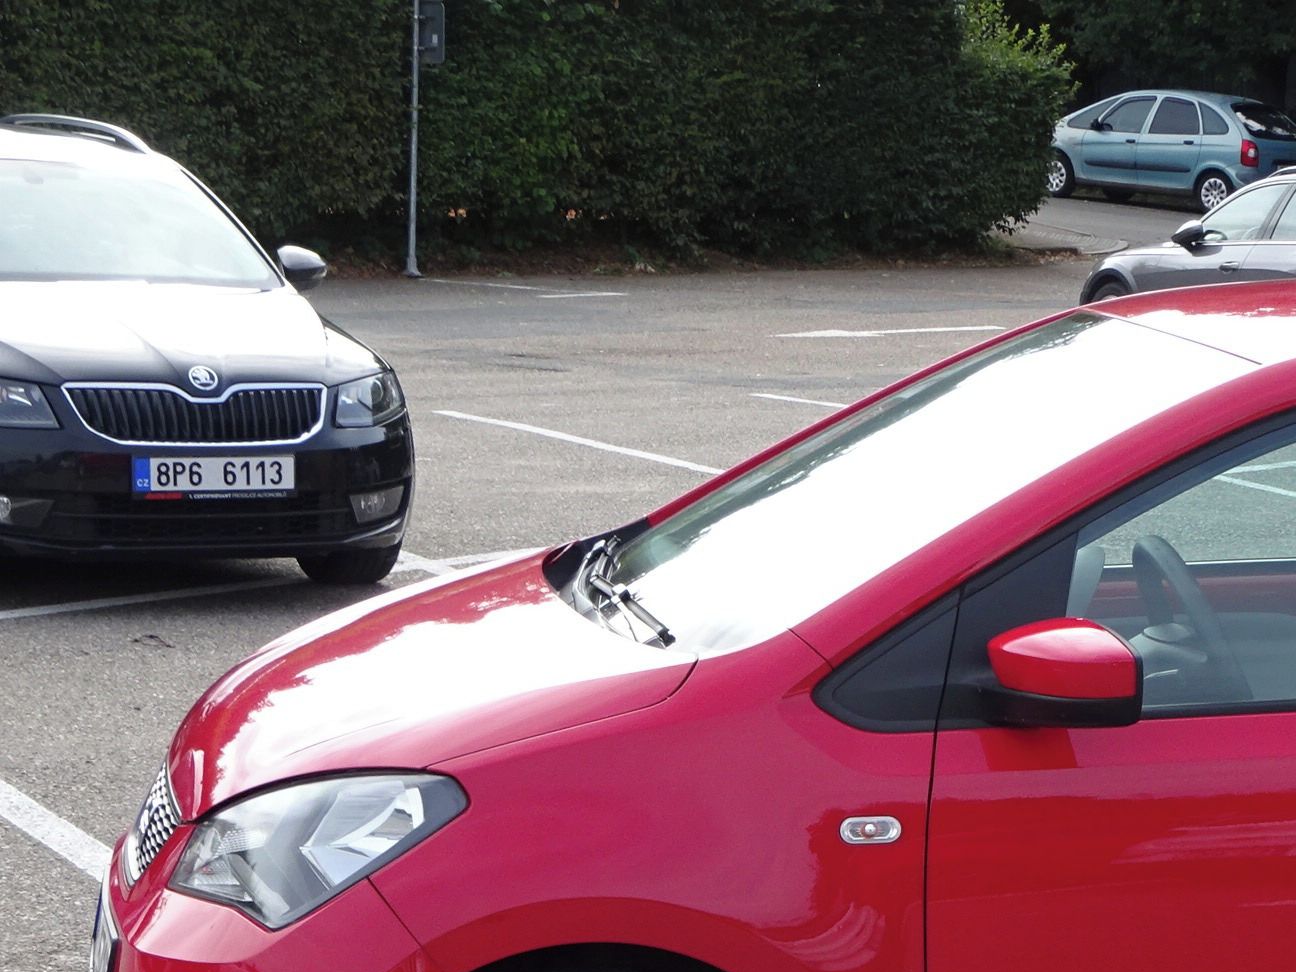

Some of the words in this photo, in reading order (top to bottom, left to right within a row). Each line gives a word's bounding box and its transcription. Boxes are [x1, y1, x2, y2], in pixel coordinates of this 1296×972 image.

[156, 461, 203, 487] 8P6
[222, 460, 283, 487] 6113
[136, 478, 150, 488] CZ
